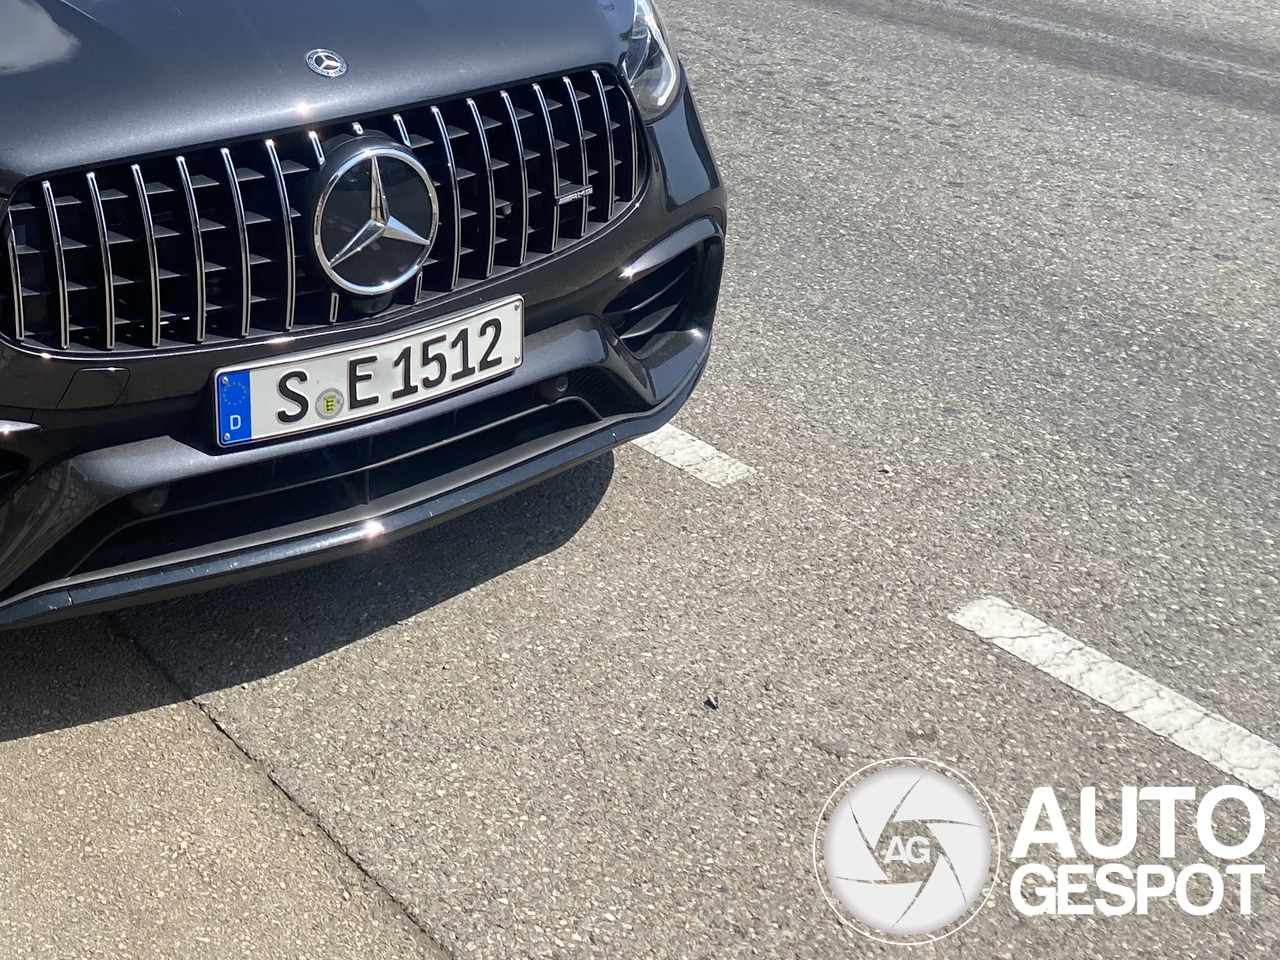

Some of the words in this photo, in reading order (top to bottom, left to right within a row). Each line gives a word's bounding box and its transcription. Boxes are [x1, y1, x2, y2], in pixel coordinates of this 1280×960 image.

[276, 370, 309, 423] S
[348, 355, 380, 410] E
[392, 318, 502, 400] 1512
[230, 415, 242, 431] D
